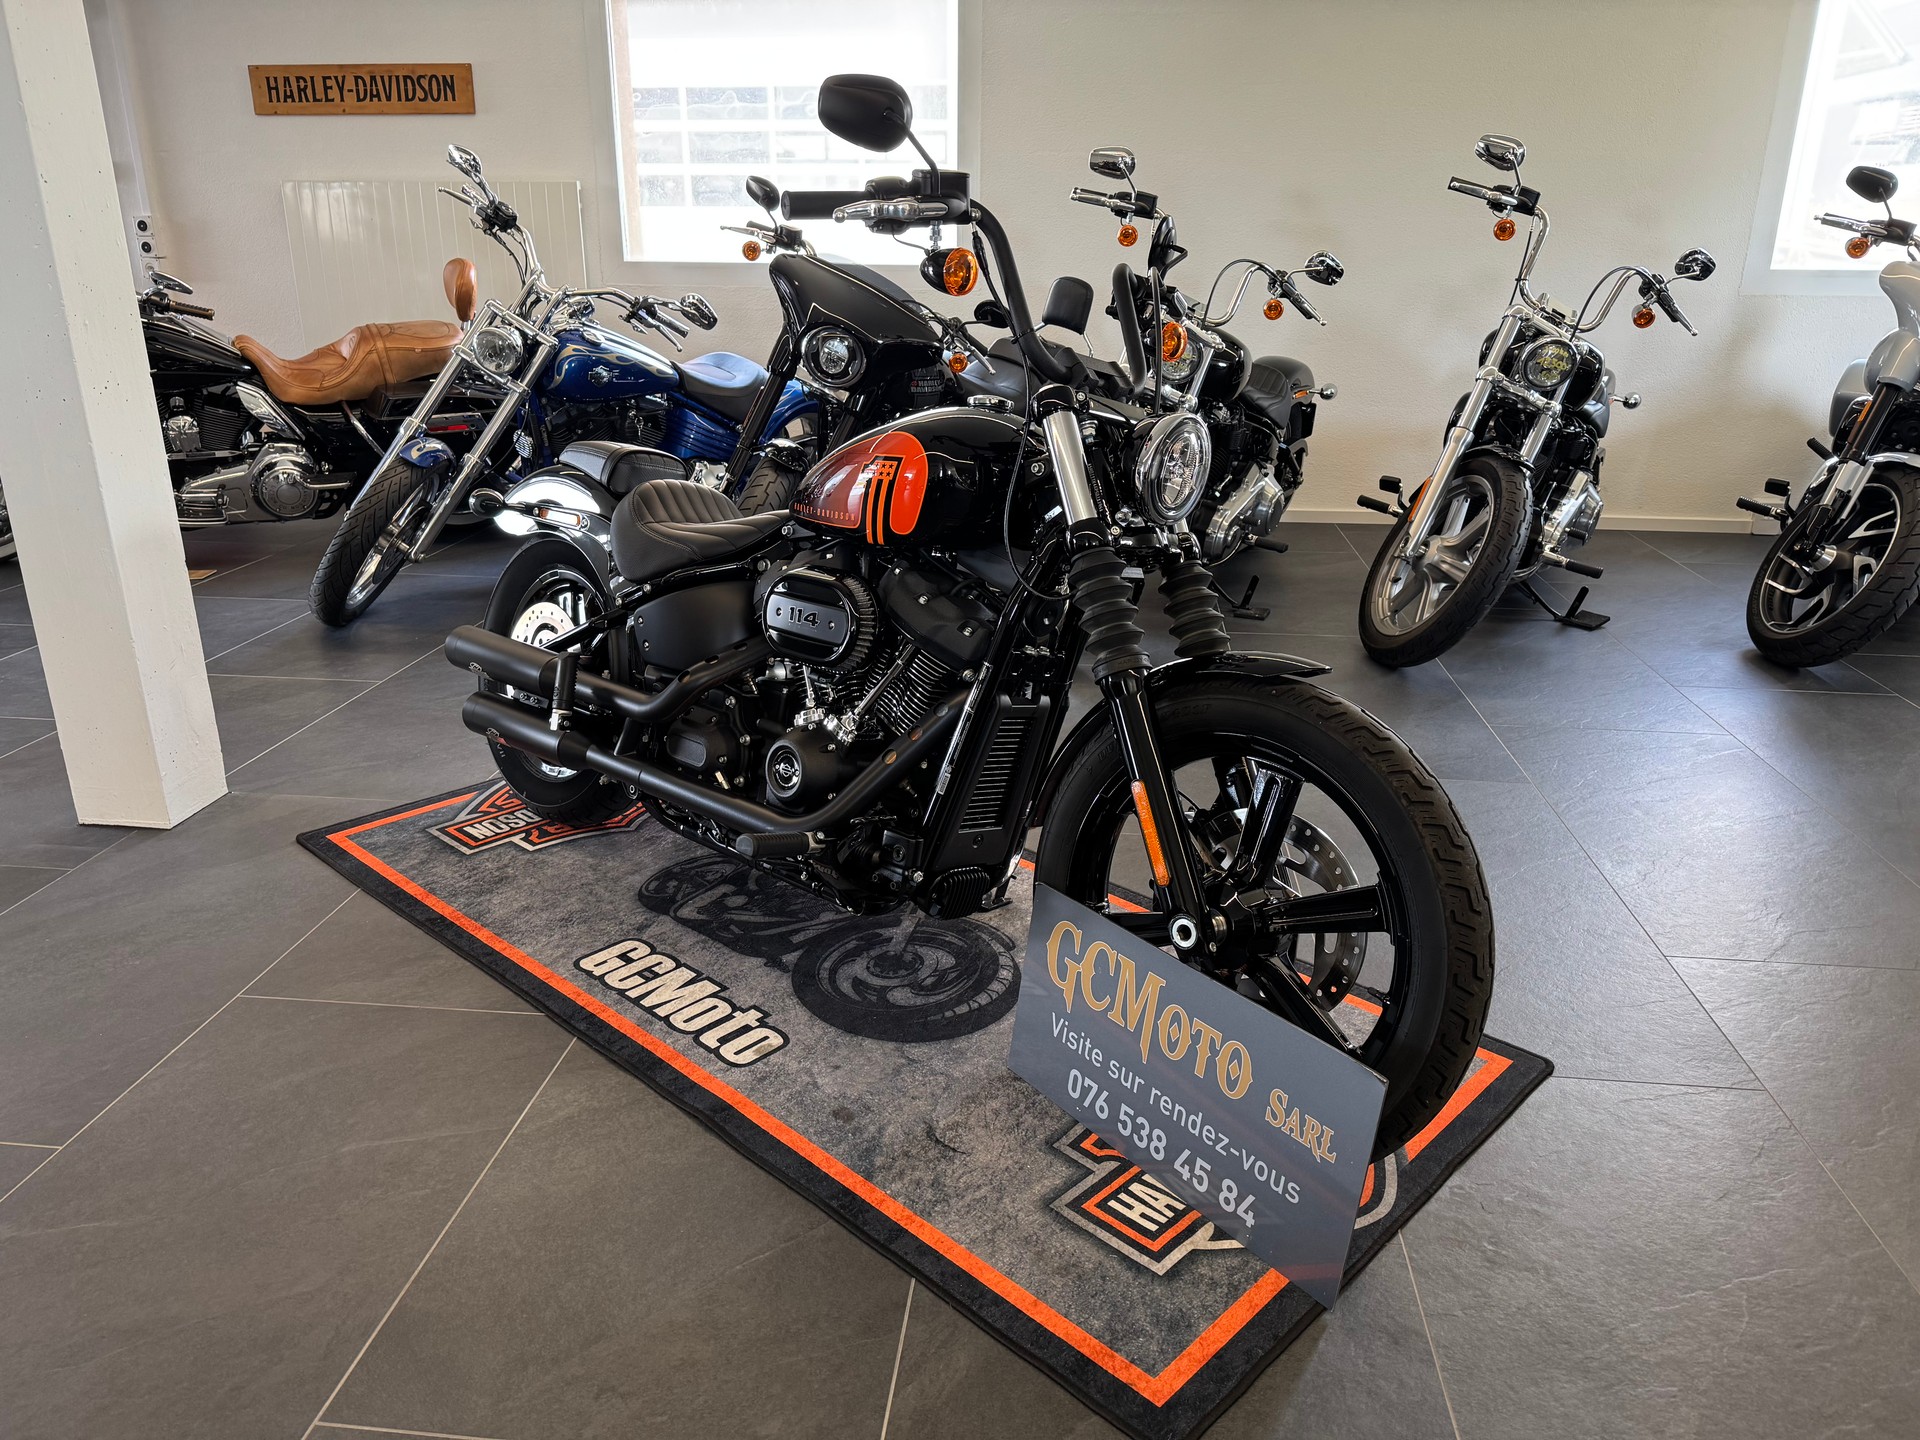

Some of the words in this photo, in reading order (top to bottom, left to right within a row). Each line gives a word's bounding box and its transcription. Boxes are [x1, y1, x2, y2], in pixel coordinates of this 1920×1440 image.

[265, 74, 457, 103] HARLEY-DAVIDSON
[788, 606, 820, 628] 114
[578, 939, 785, 1066] GCMoto
[1051, 1011, 1104, 1068] Visite
[1108, 1060, 1146, 1095] sur
[1148, 1086, 1301, 1205] rendez-vous
[1067, 1068, 1110, 1121] 076
[1116, 1102, 1168, 1162] 538
[1173, 1148, 1213, 1194] 45
[1217, 1178, 1256, 1228] 84
[1264, 1088, 1338, 1164] SARL
